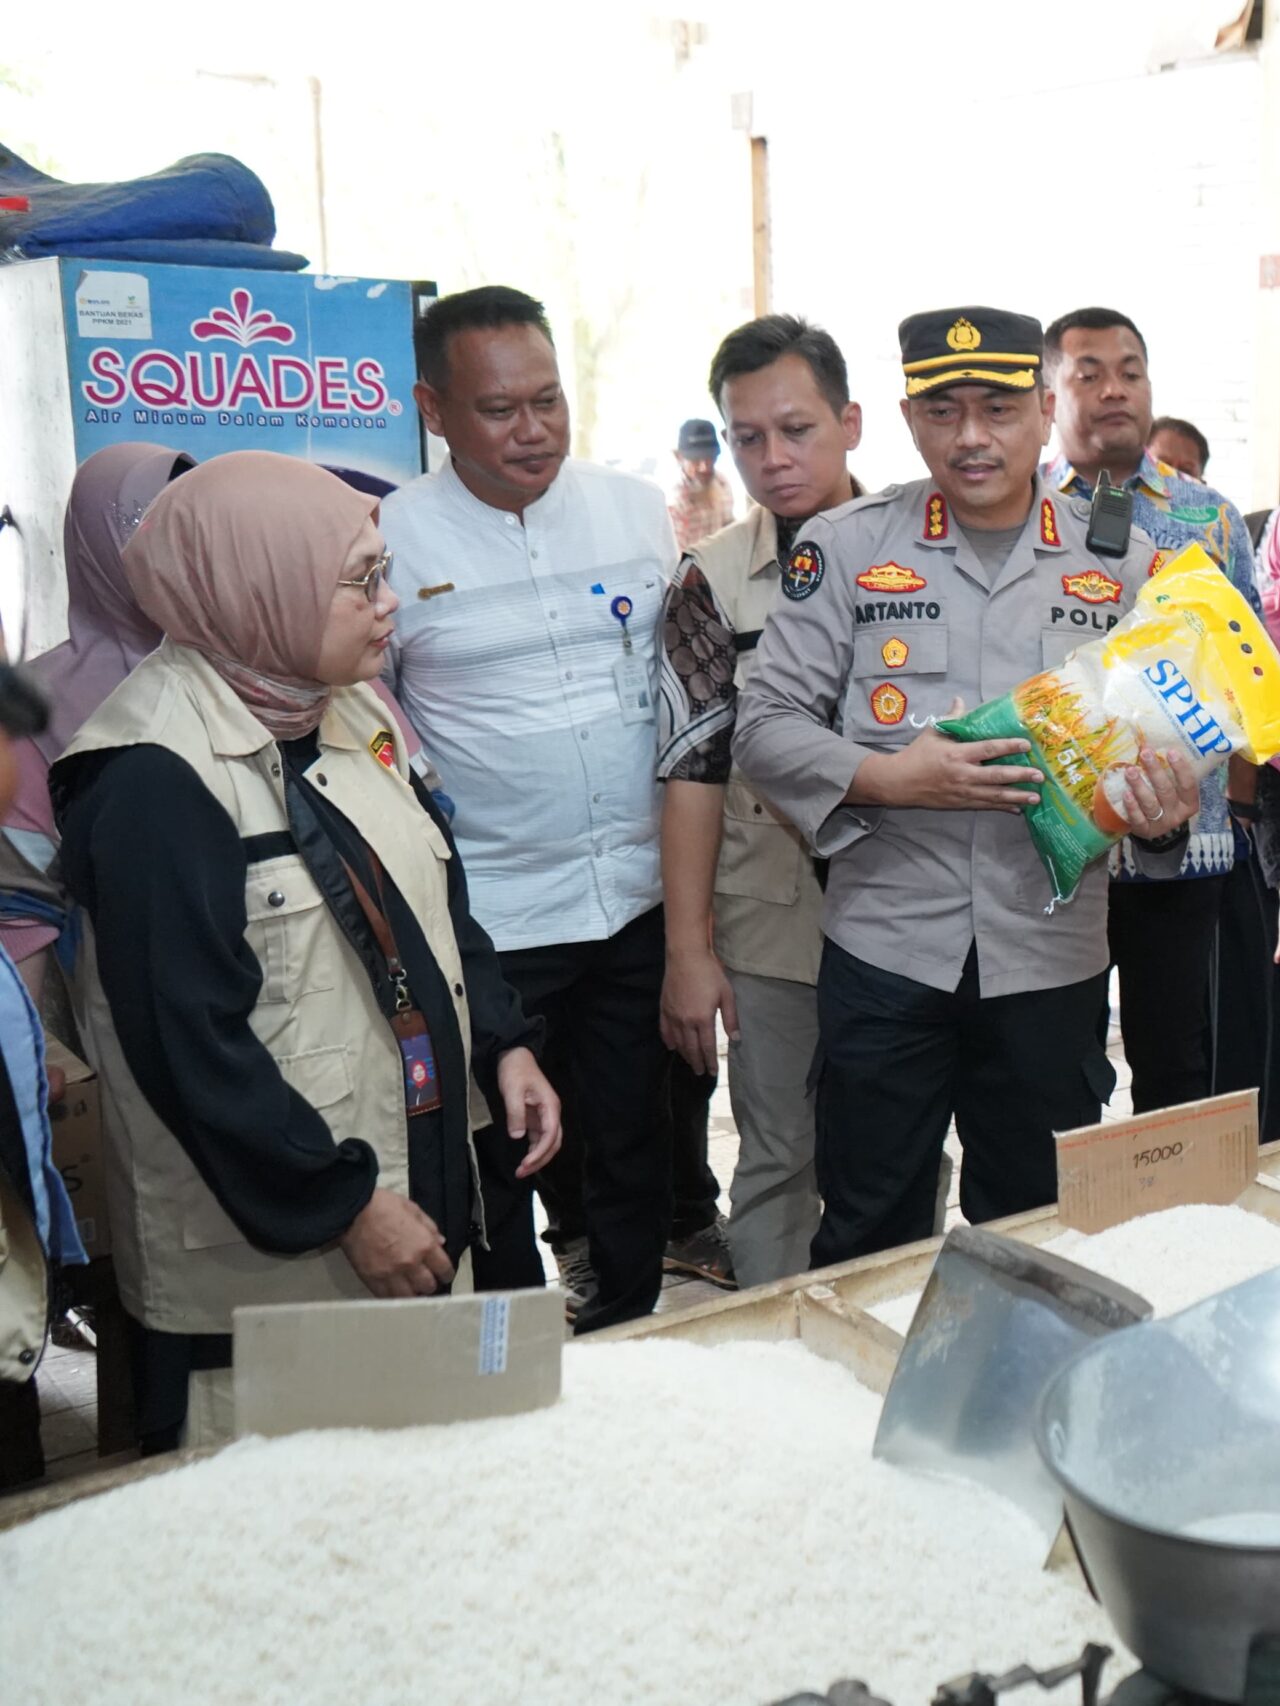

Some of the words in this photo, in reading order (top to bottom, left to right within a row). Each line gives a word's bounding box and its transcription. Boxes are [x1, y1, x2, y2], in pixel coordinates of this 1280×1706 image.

[84, 349, 388, 412] SQUADES
[85, 410, 121, 424] Air
[133, 410, 206, 425] Minum
[218, 411, 285, 426] Dalam
[296, 413, 386, 428] Kemasan
[855, 601, 941, 624] ARTANTO
[1051, 606, 1119, 632] POLR
[1144, 659, 1233, 759] SPHP
[1057, 748, 1077, 766] 5
[1133, 1142, 1183, 1168] 15000
